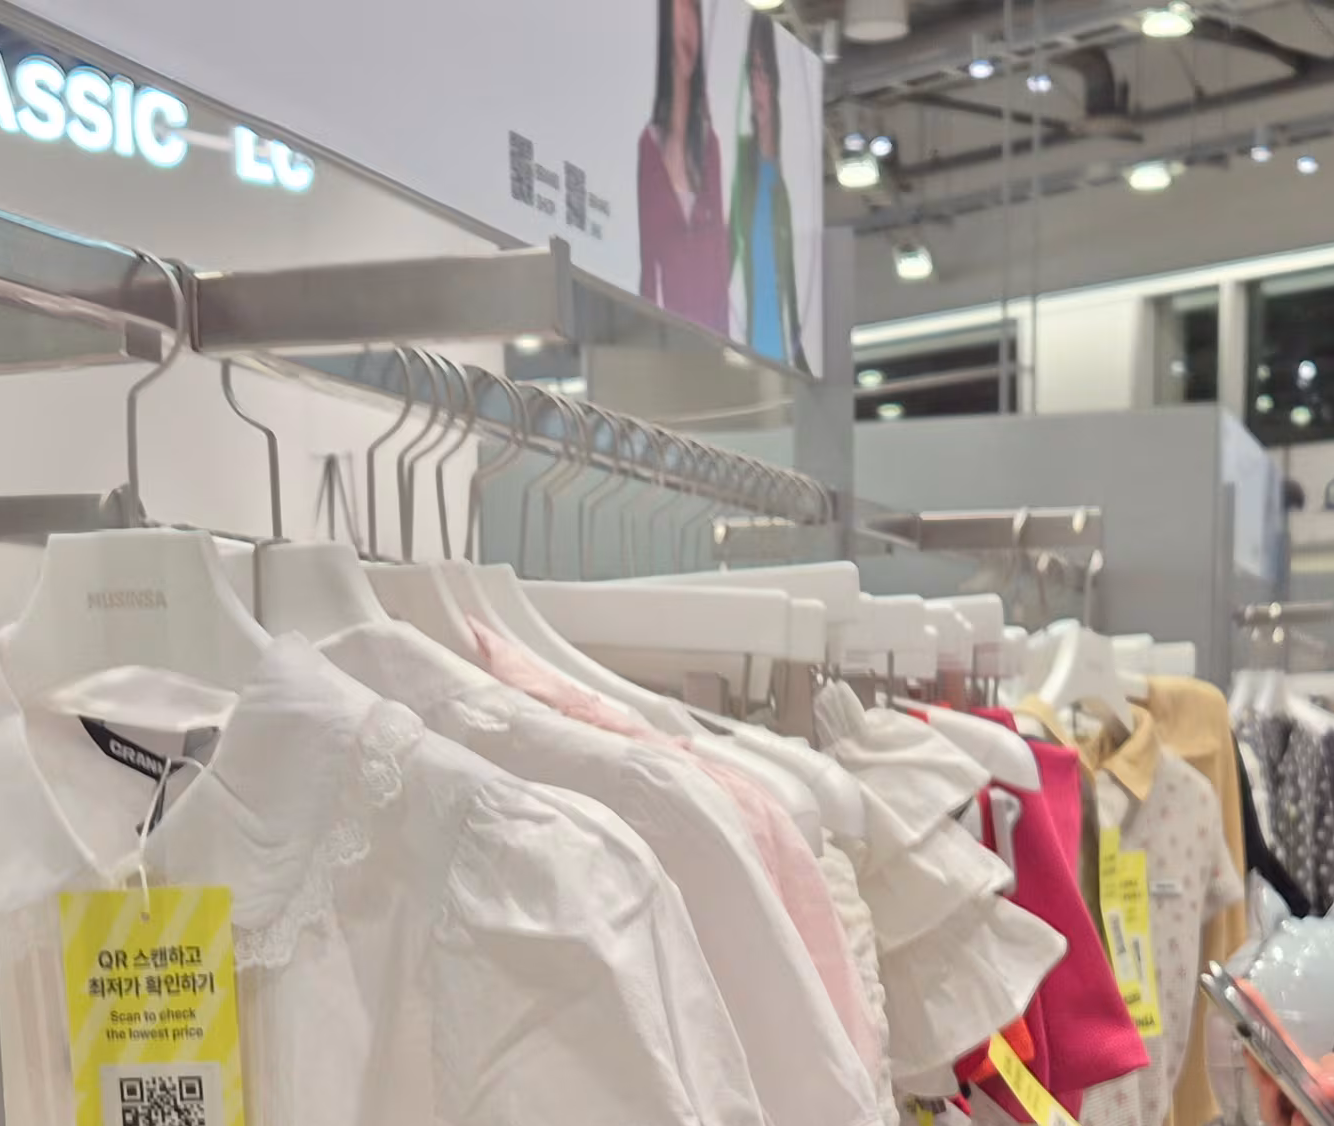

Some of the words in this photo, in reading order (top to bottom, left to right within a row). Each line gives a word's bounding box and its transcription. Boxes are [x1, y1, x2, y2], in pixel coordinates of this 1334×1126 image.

[87, 590, 169, 610] MUSINSA
[98, 949, 128, 970] QR
[133, 944, 202, 969] 스캔하고
[88, 975, 141, 1000] 최저가
[145, 971, 216, 996] 확인하기
[110, 1010, 141, 1023] Scan
[143, 1009, 157, 1022] to
[159, 1007, 197, 1021] check
[106, 1028, 126, 1041] the
[129, 1027, 169, 1040] lowest
[172, 1025, 204, 1042] price
